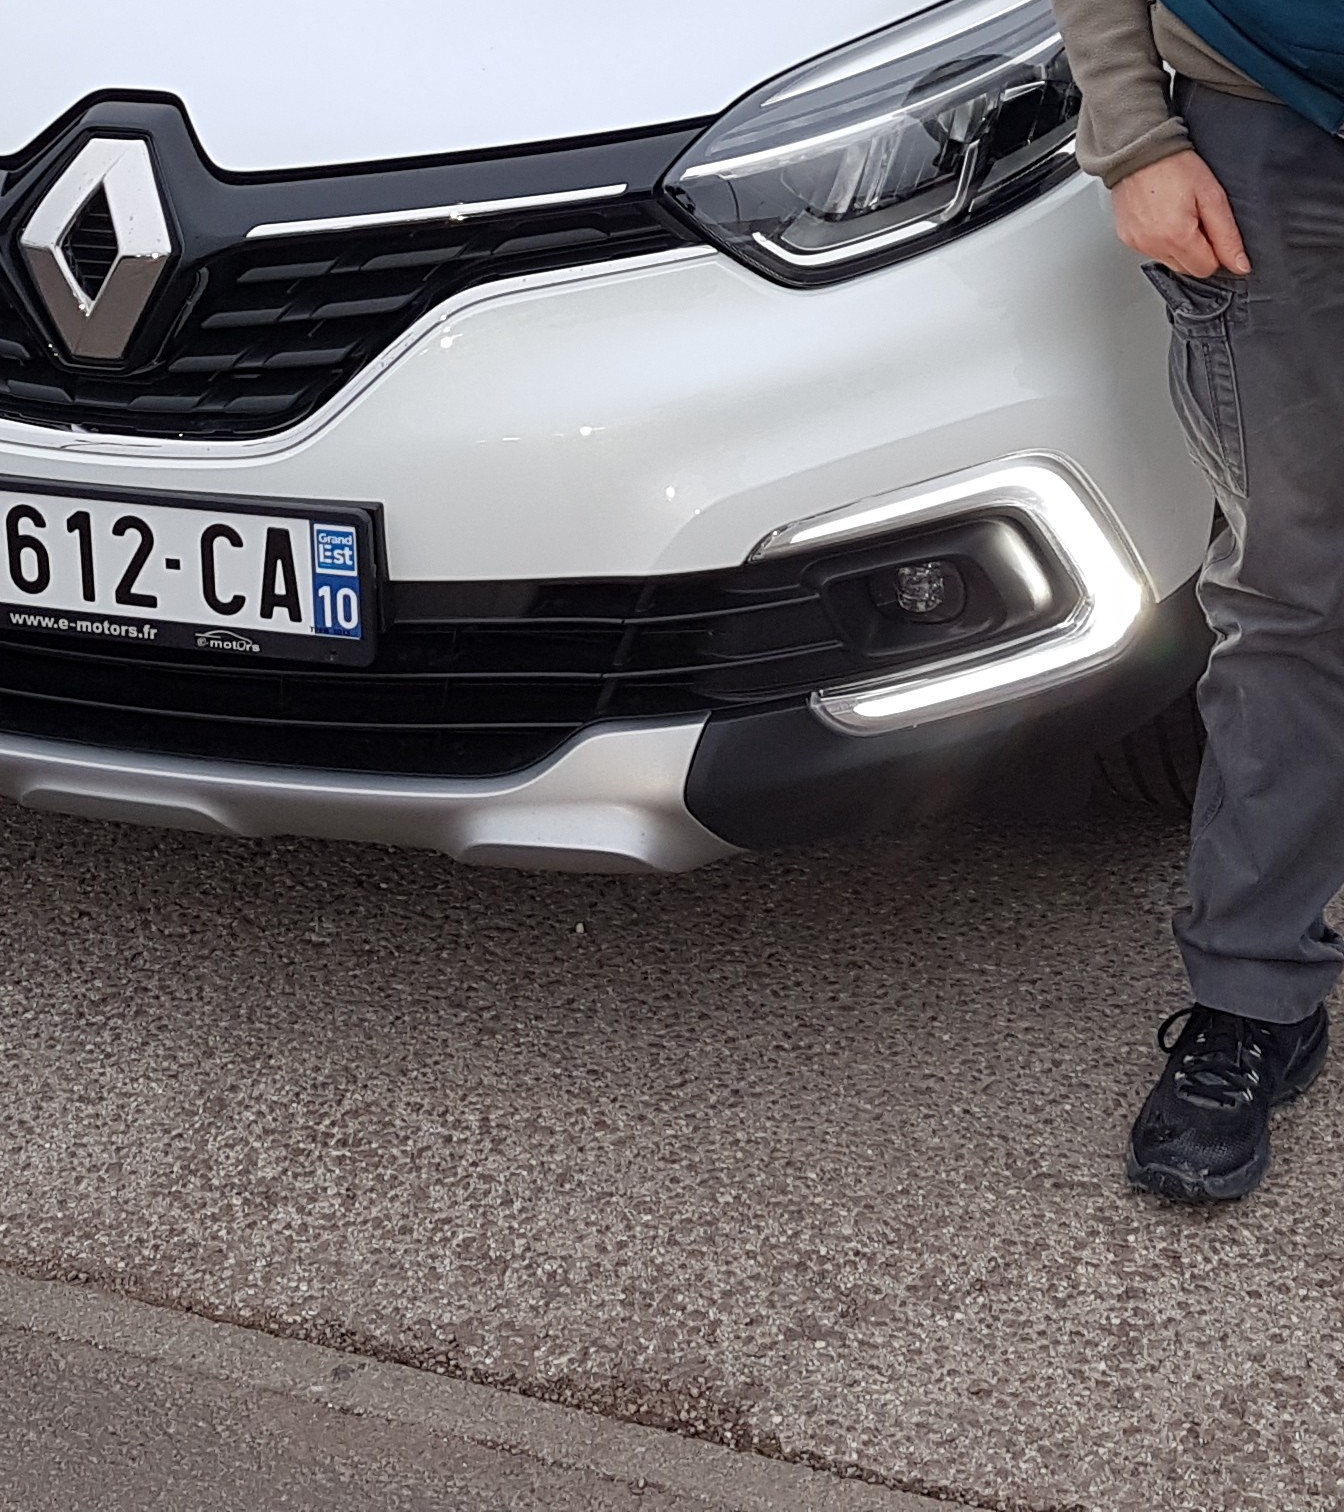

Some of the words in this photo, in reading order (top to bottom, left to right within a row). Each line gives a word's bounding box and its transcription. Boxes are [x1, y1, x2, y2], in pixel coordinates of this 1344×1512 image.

[318, 532, 353, 546] Grand
[318, 544, 354, 566] Est
[318, 584, 359, 630] 10
[9, 612, 158, 639] www.e-motors.fr
